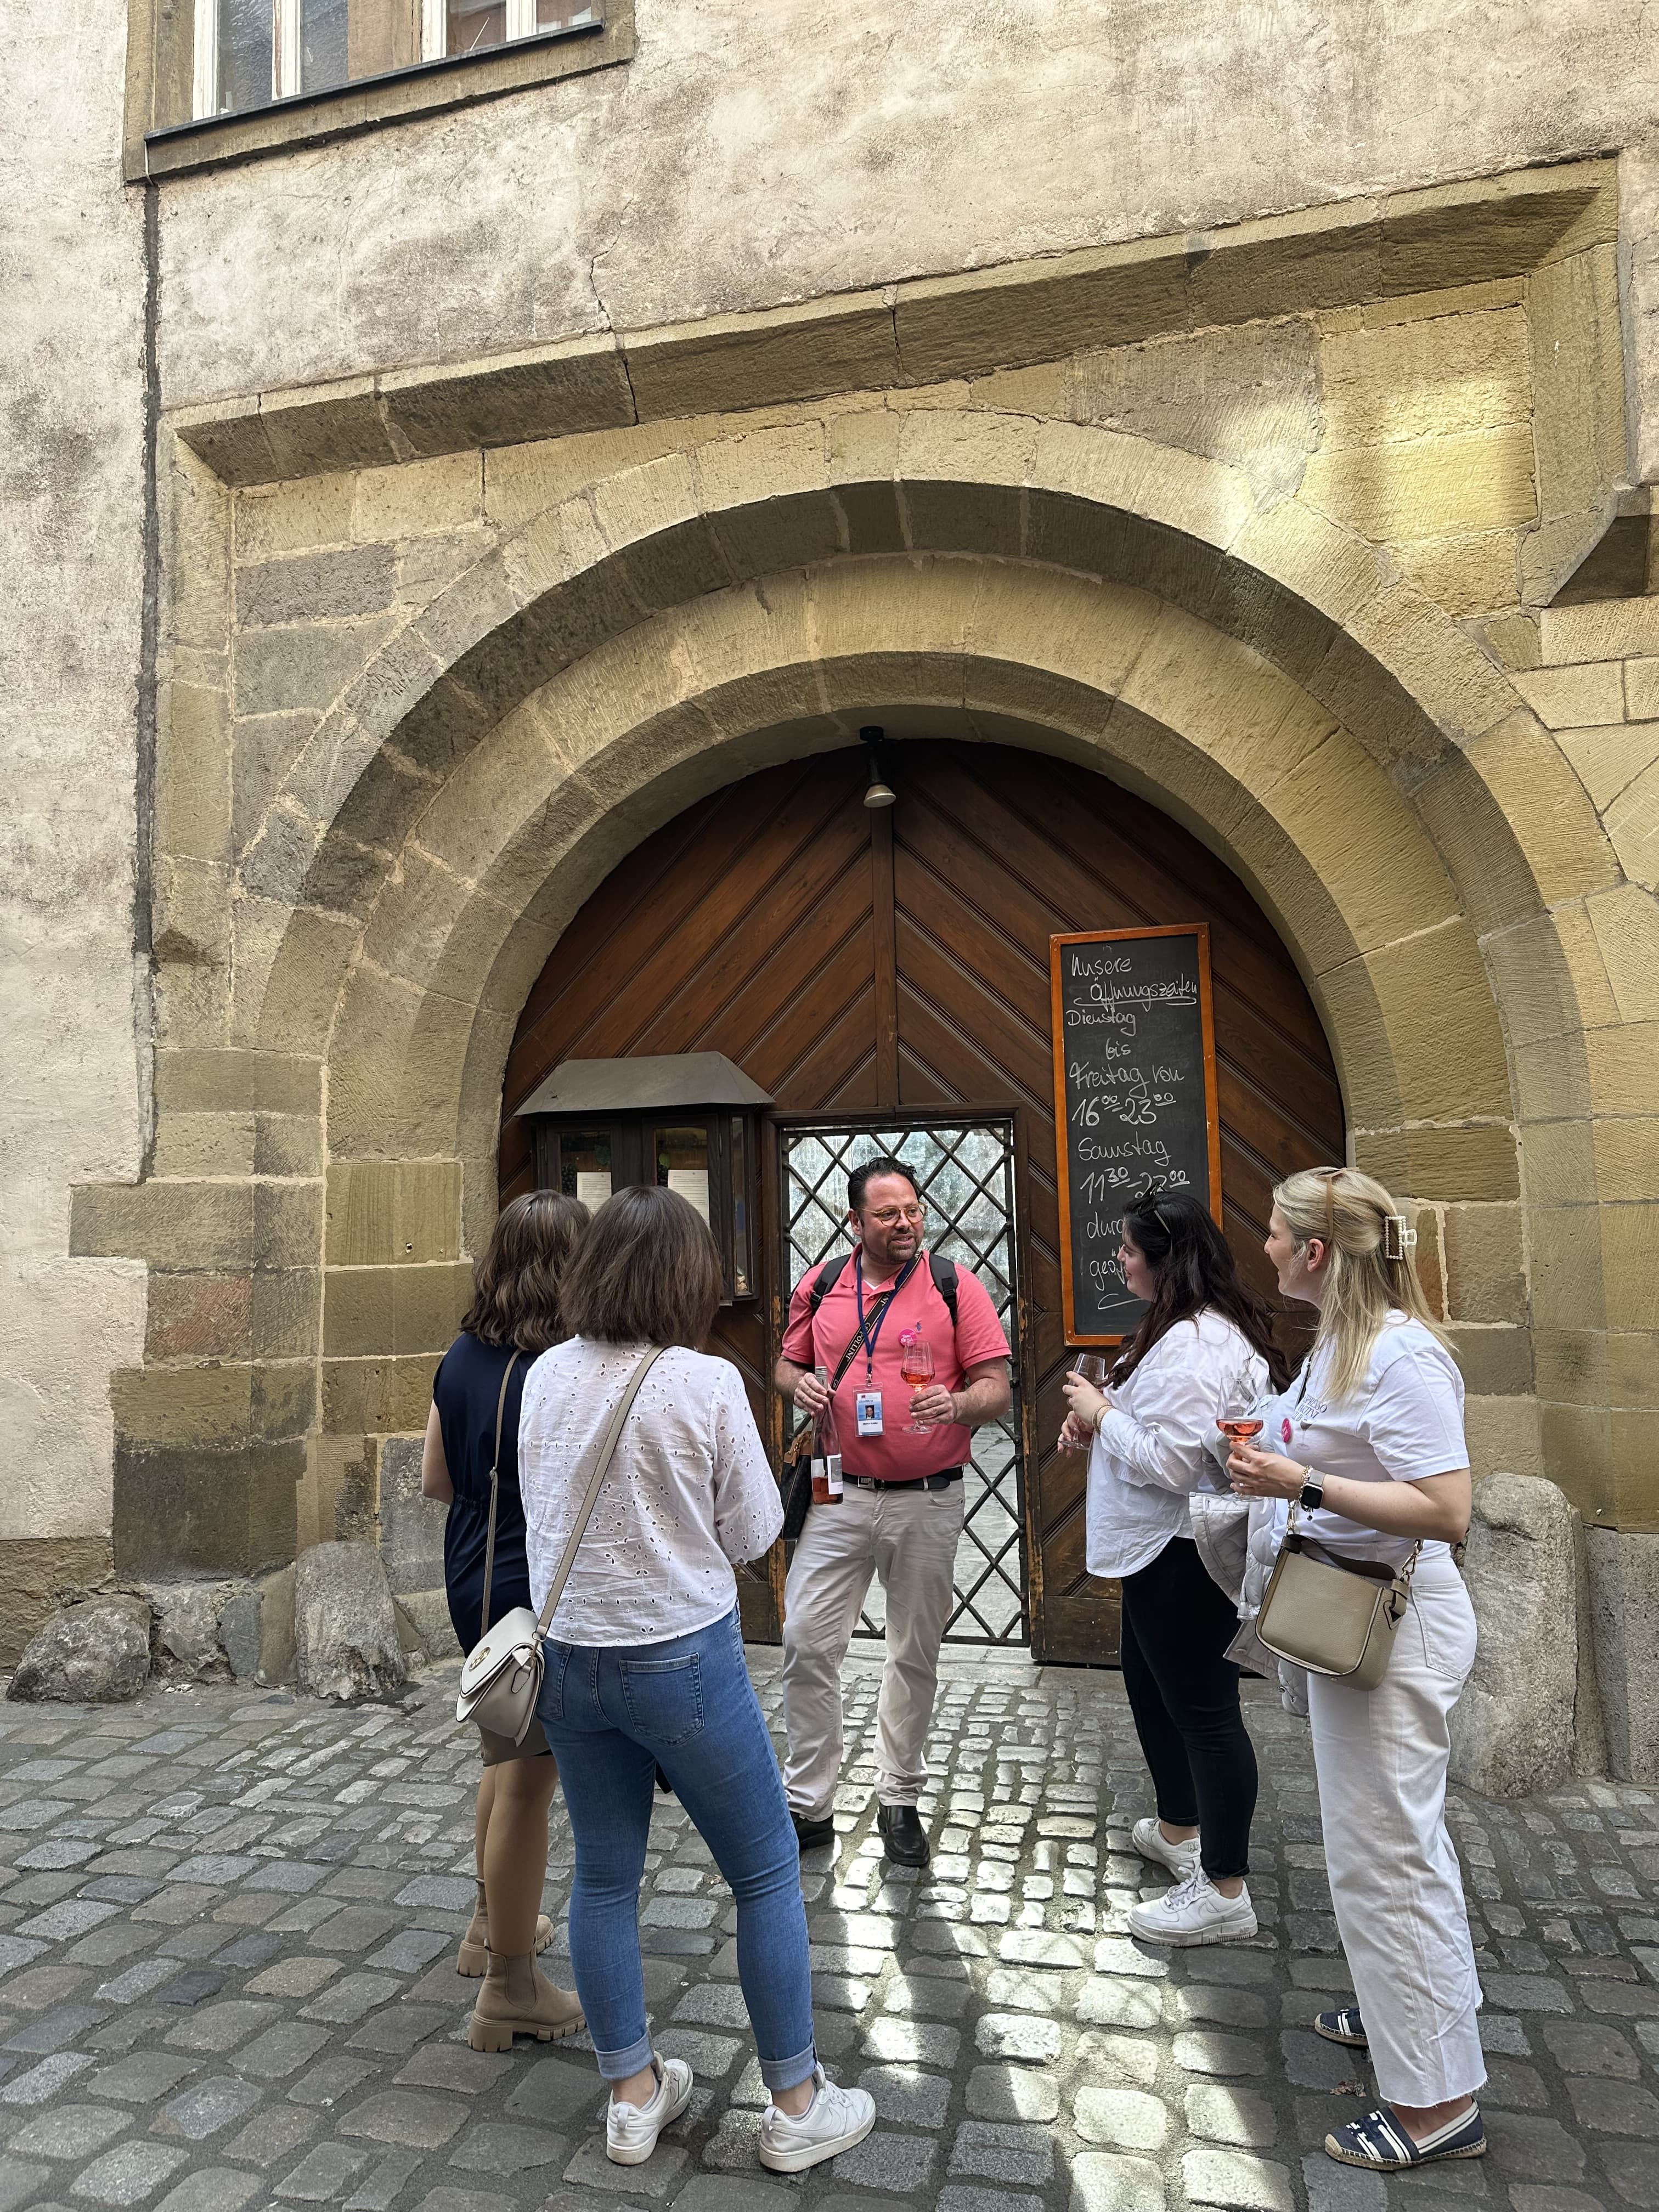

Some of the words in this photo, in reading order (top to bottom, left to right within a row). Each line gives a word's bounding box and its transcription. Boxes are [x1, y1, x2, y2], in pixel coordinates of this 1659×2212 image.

[1071, 953, 1132, 976] Unsere
[1090, 973, 1198, 1012] Öffnungszeiten
[1066, 1009, 1136, 1036] Dienstag
[1105, 1037, 1131, 1059] bis
[1070, 1062, 1150, 1099] Freitag
[1078, 1131, 1172, 1166] Samstag
